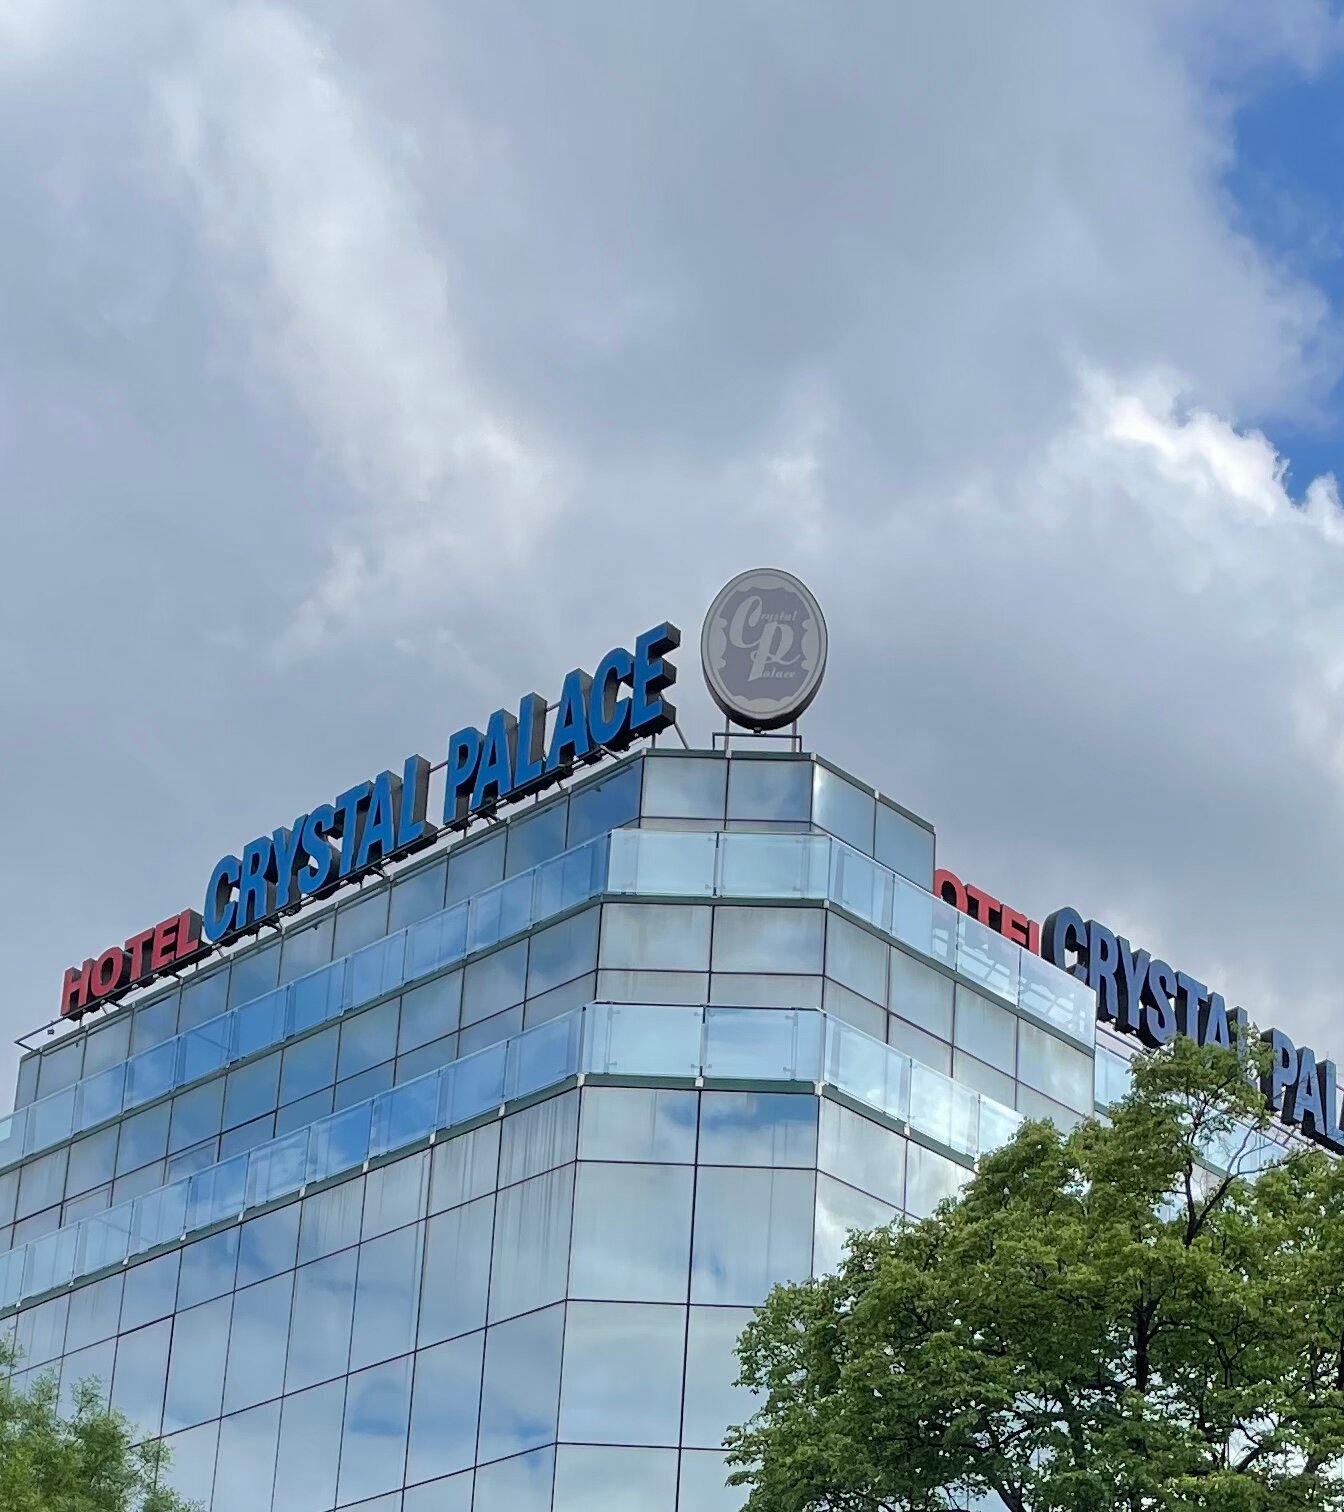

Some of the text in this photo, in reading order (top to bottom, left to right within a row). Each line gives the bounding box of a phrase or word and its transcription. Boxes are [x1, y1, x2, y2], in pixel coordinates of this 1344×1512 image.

[61, 621, 681, 1017] HOTEL CRYSTAL PALACE
